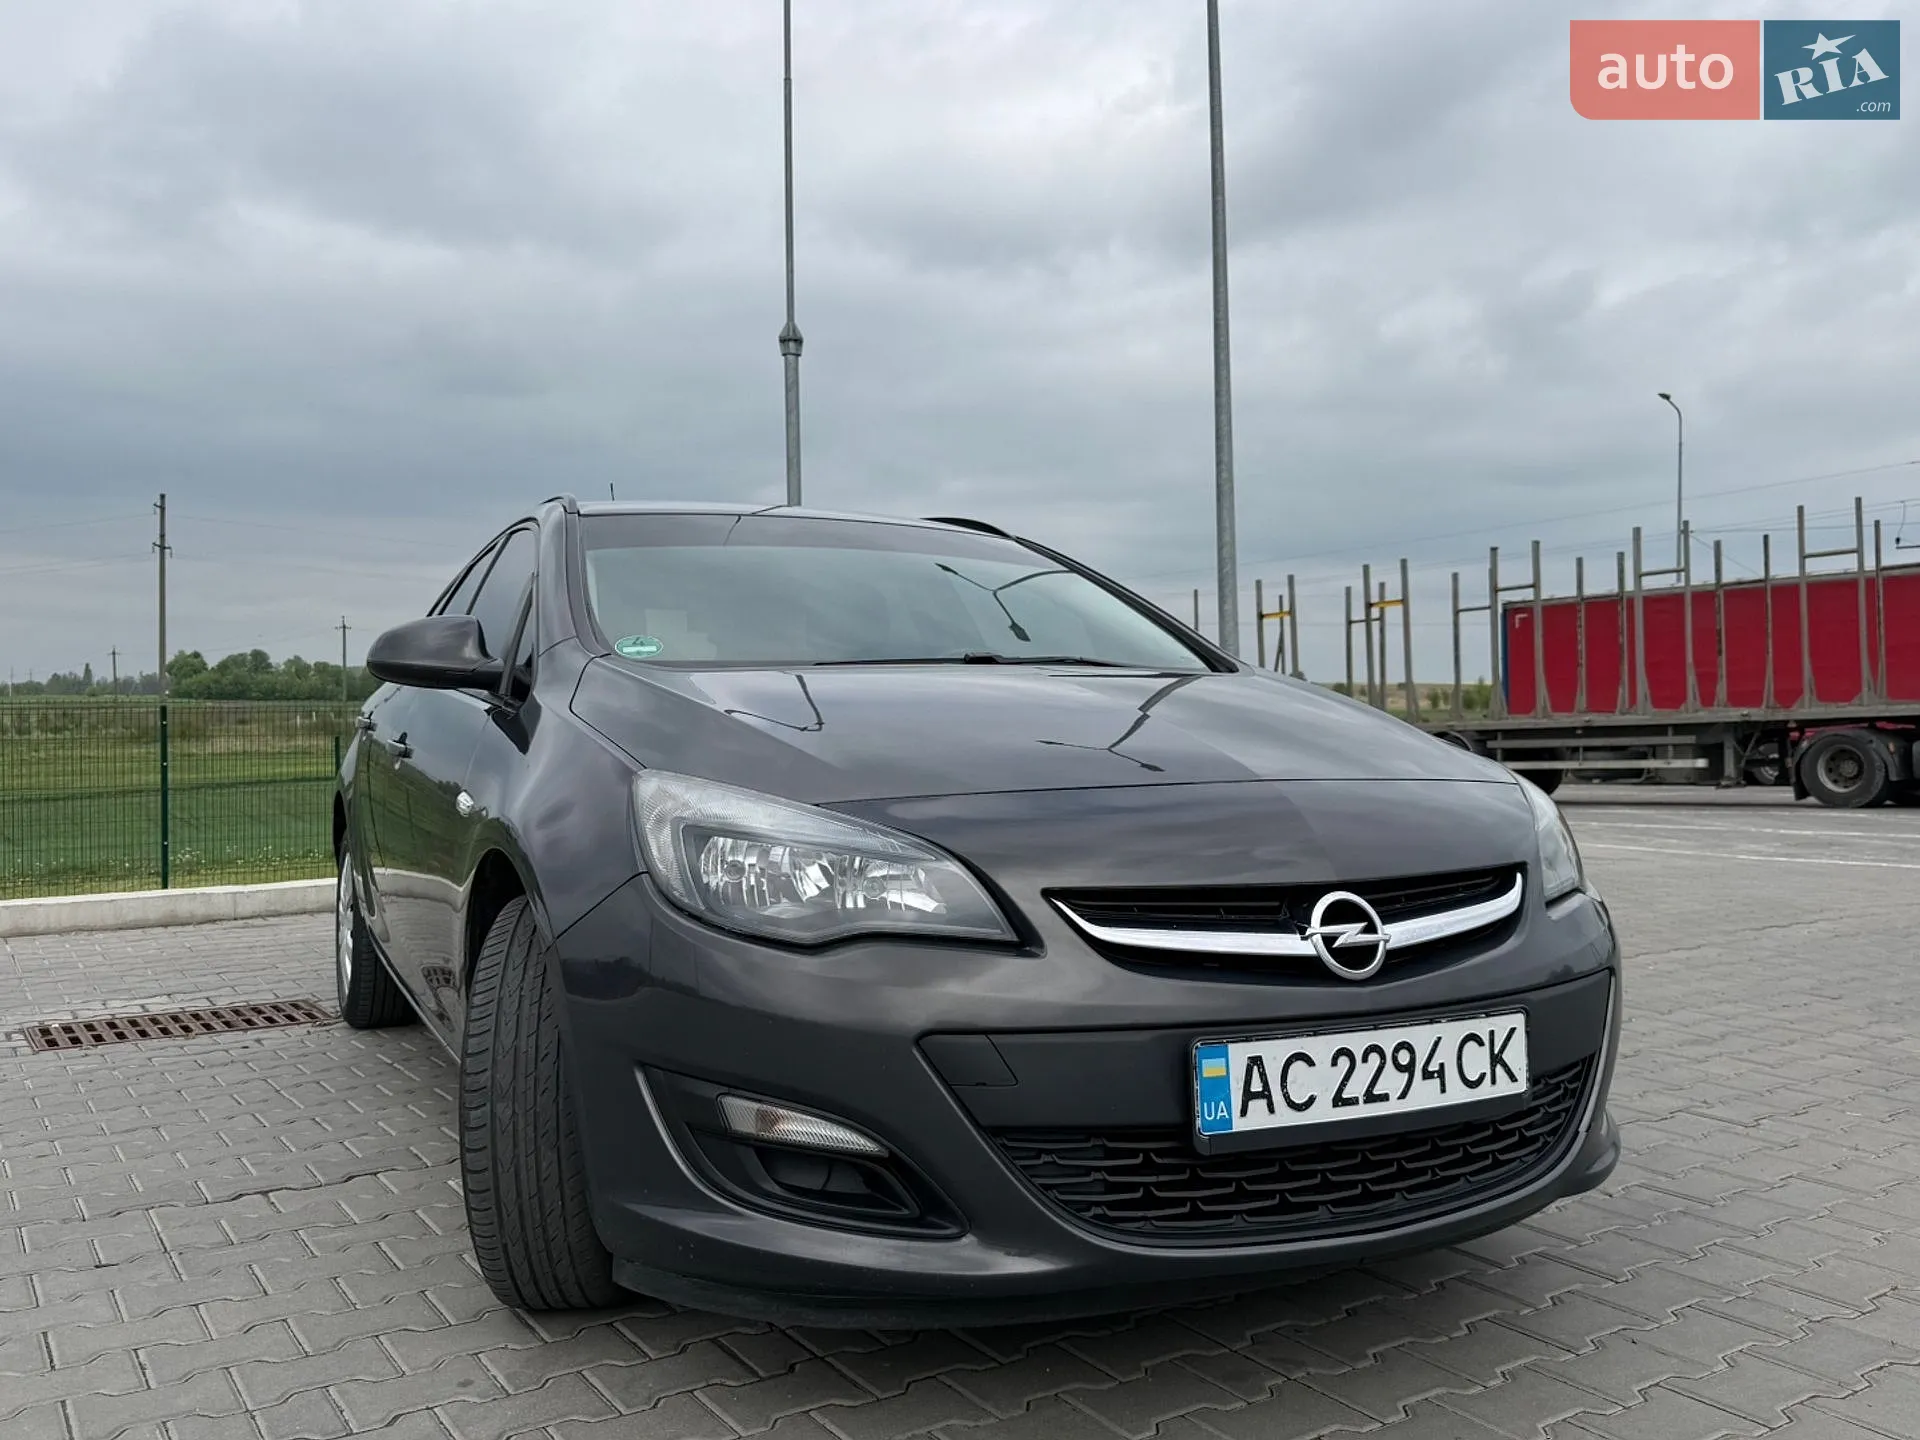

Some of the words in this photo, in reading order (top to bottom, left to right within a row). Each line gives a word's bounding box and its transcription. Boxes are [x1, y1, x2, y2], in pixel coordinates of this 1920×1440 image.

[1239, 1051, 1317, 1118] AC
[1330, 1036, 1447, 1108] 2294
[1456, 1027, 1519, 1090] CK
[1203, 1101, 1229, 1121] UA
